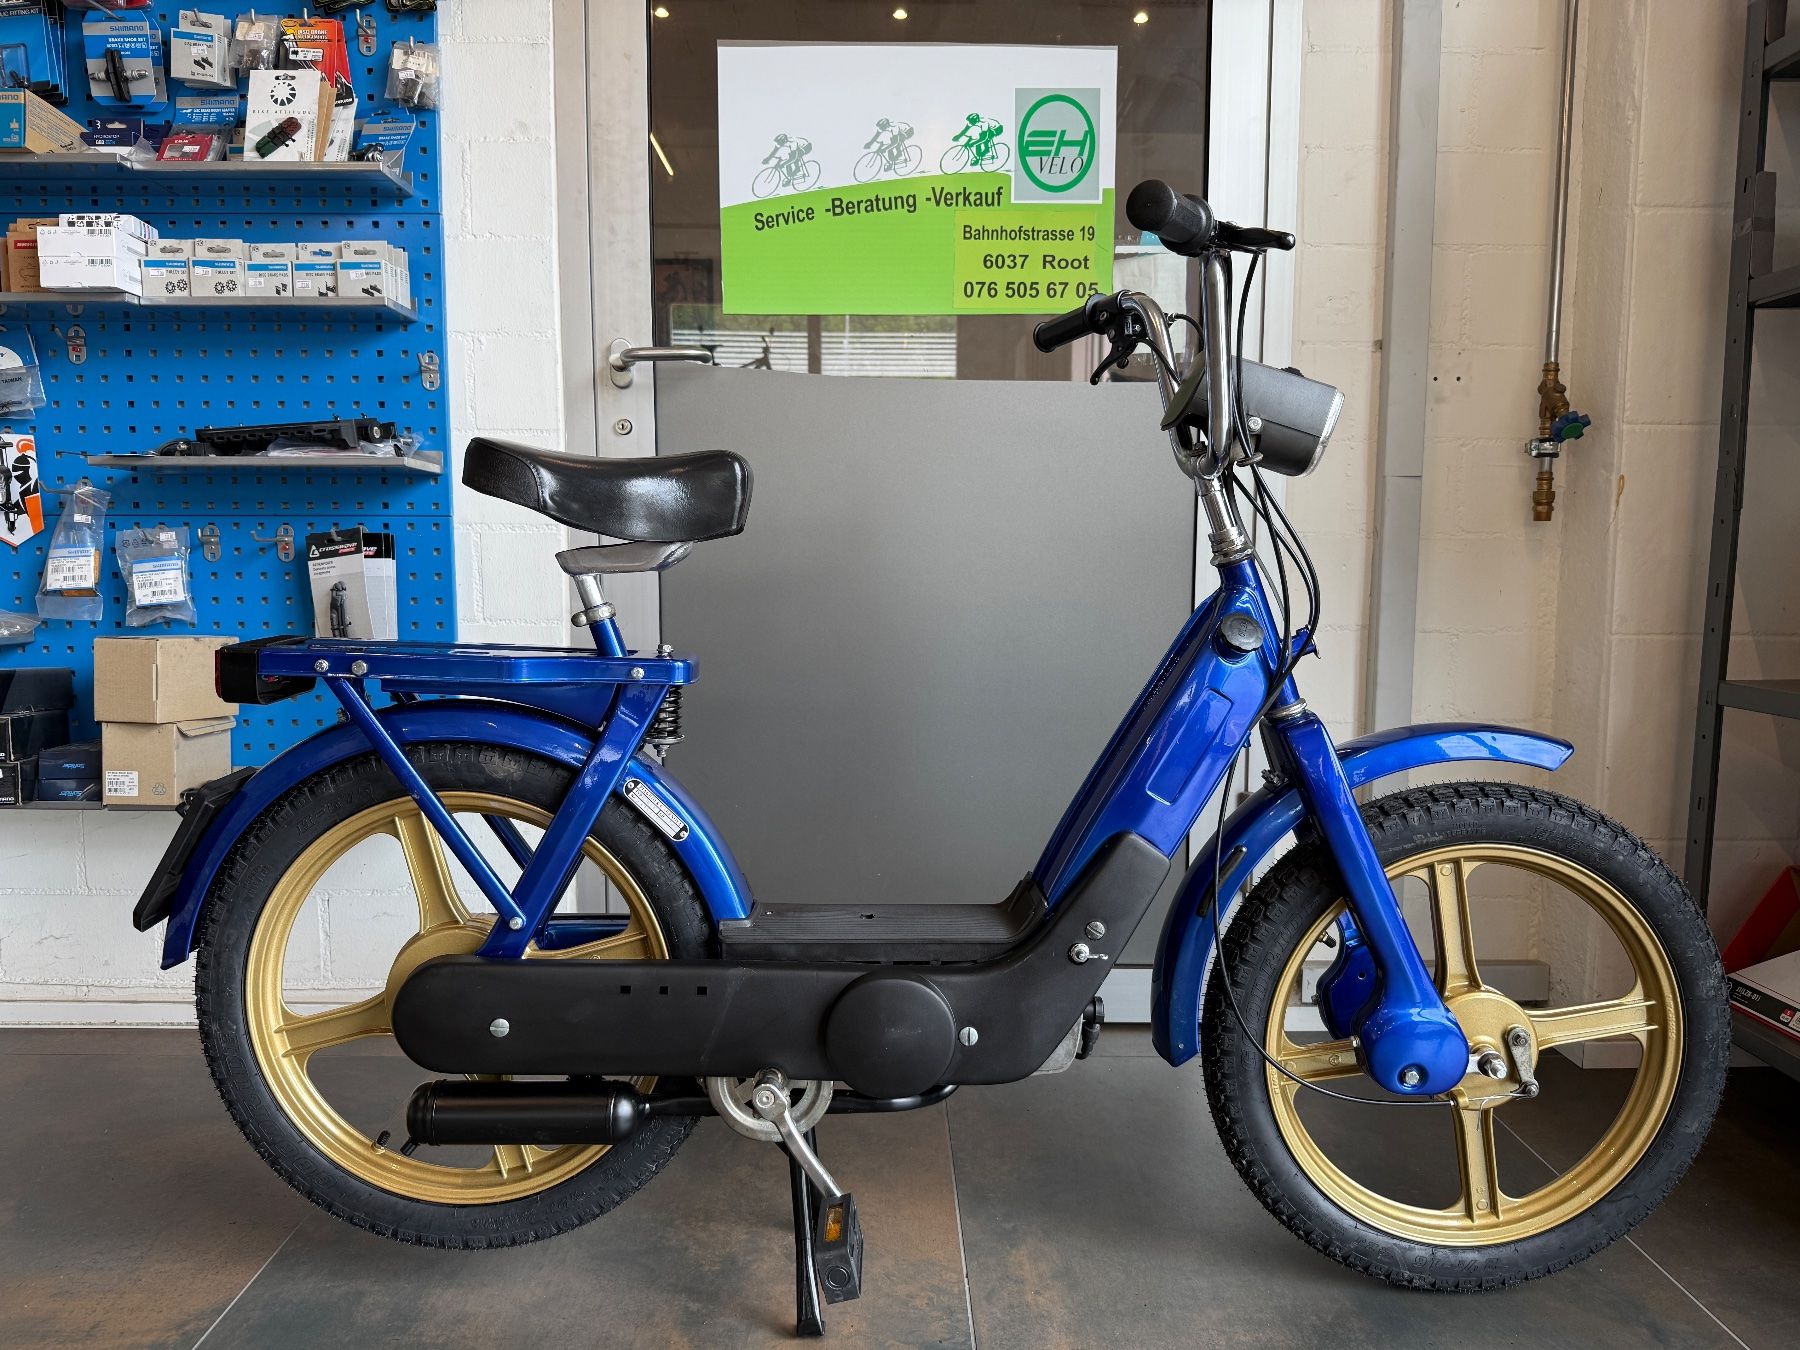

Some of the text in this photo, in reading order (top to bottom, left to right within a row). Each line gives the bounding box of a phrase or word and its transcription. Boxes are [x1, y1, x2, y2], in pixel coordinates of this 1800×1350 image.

[1038, 155, 1085, 175] VELO
[753, 186, 1004, 232] Service -Beratung -Verkauf
[962, 224, 1095, 242] Bahnhofstrasse 19
[982, 253, 1090, 270] 6037 Root
[963, 281, 1099, 299] 076 505 67 05
